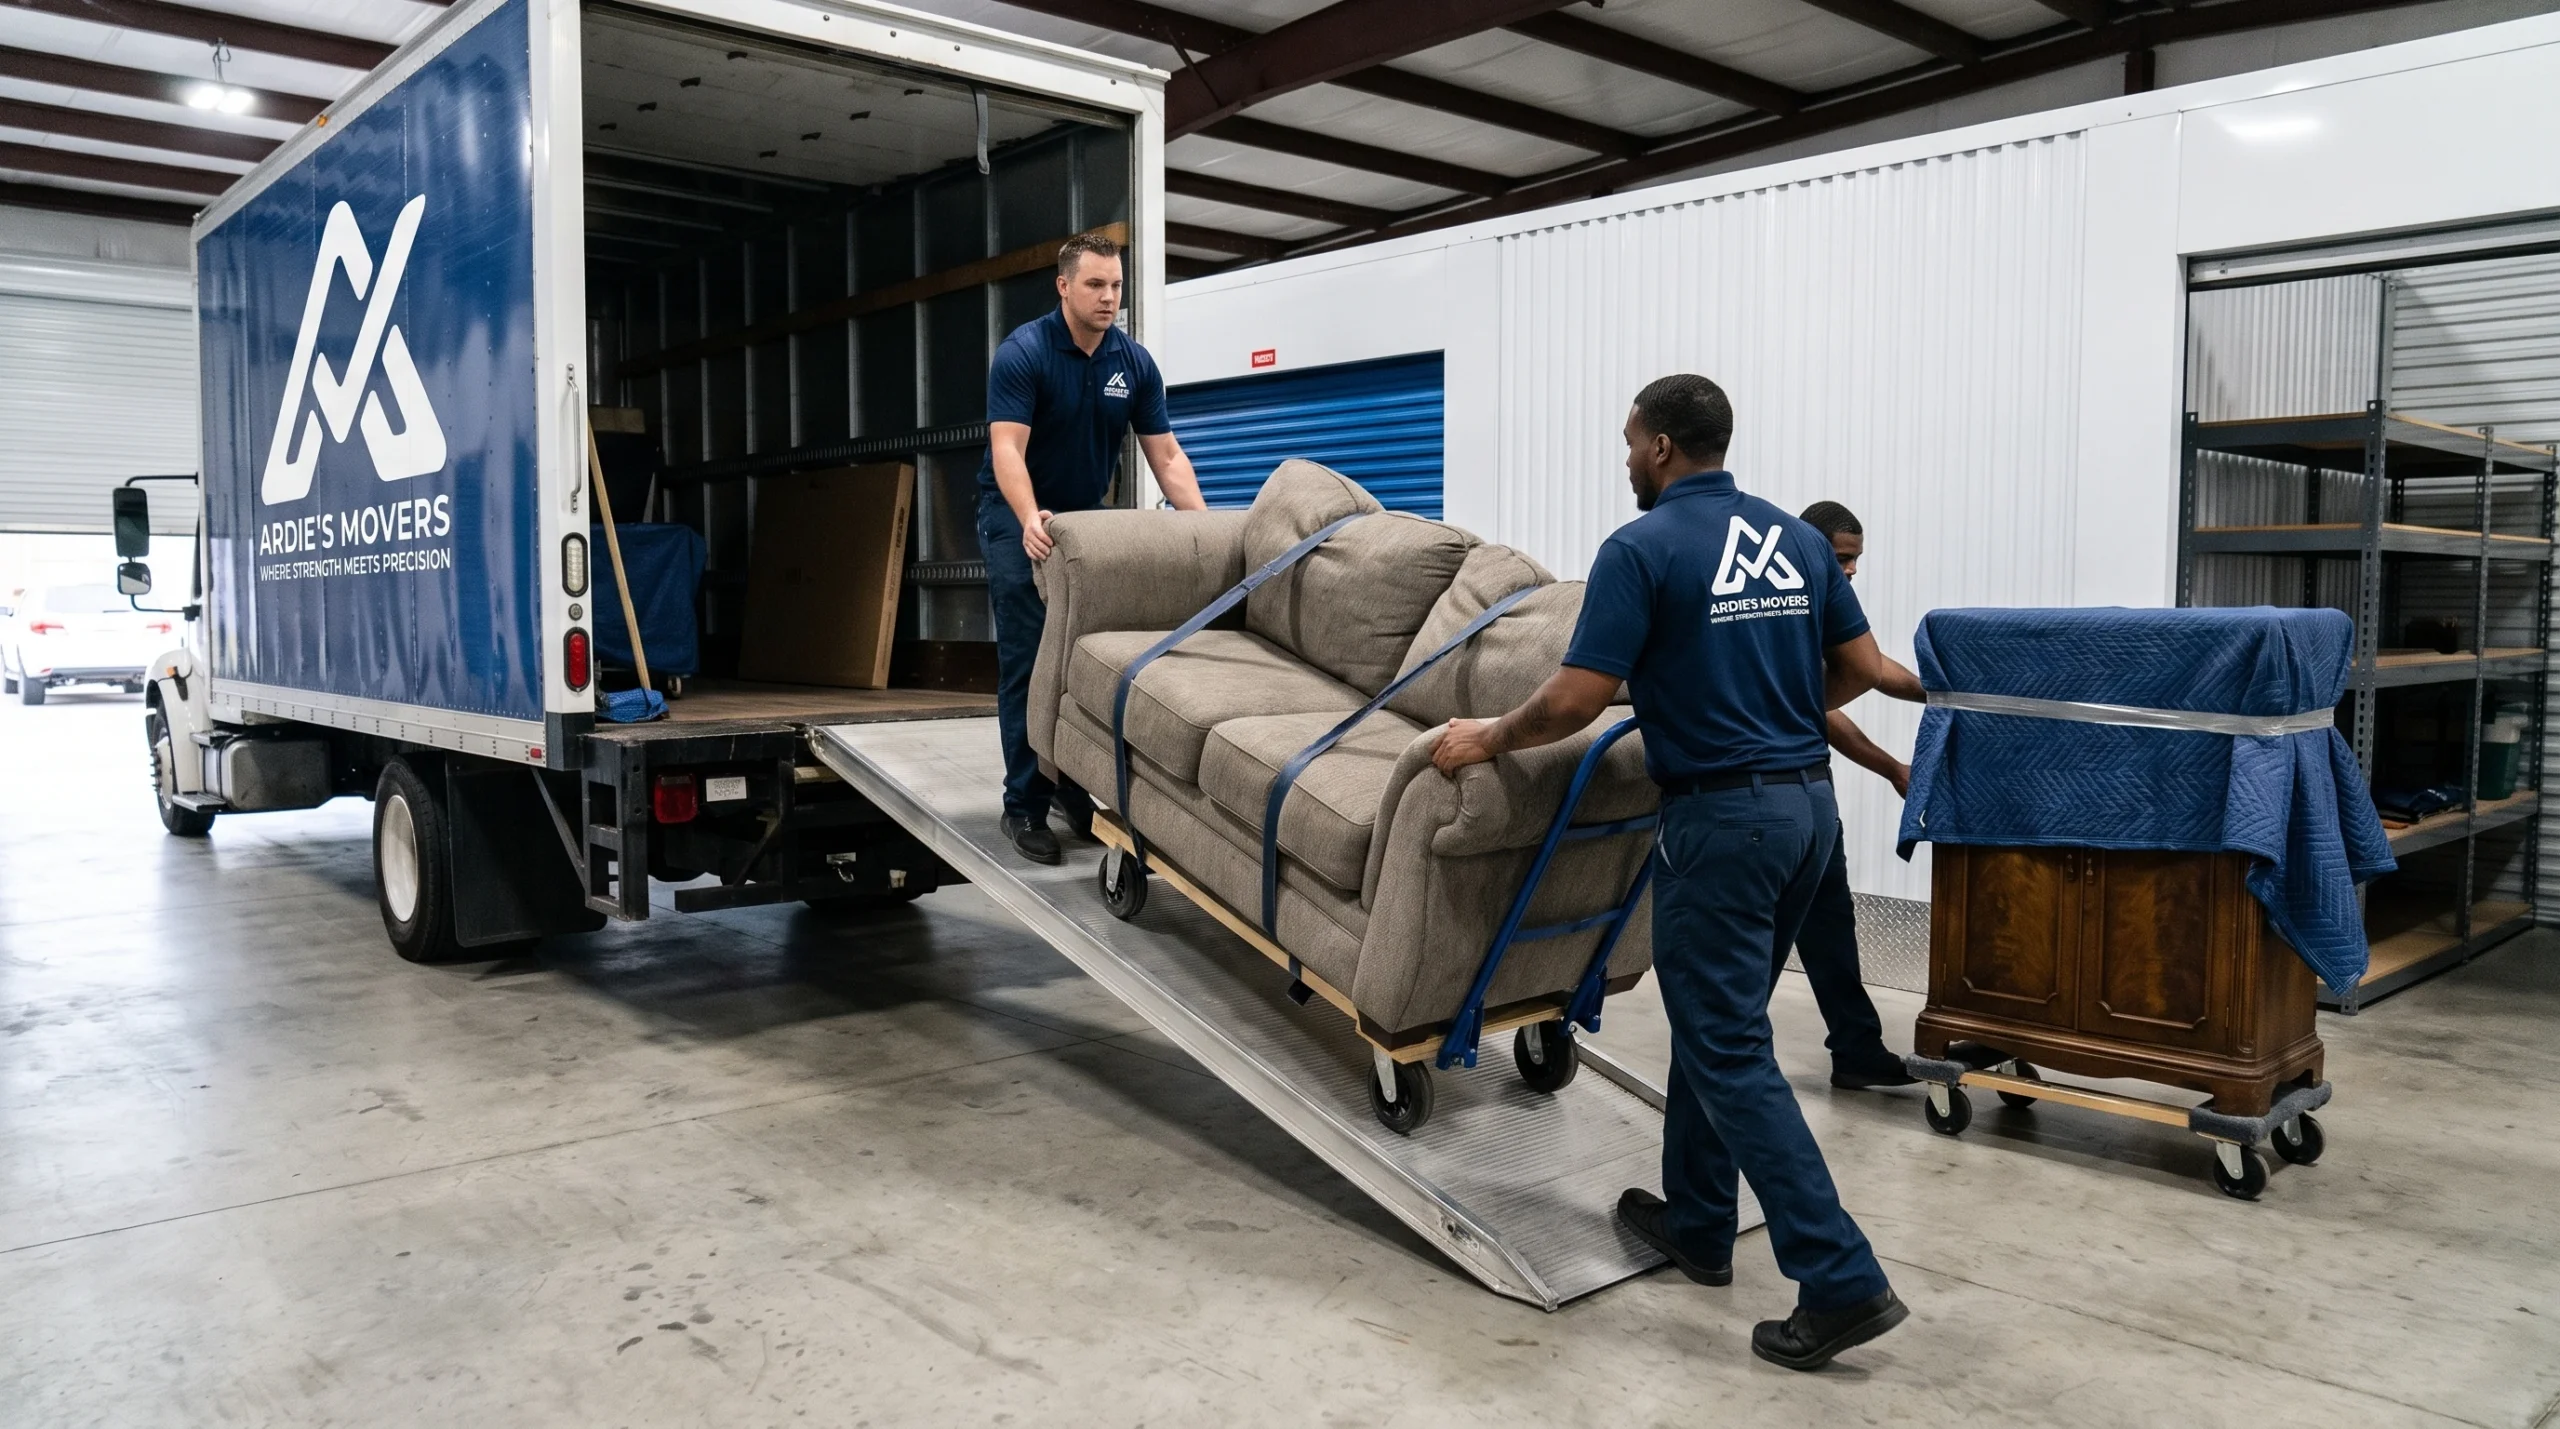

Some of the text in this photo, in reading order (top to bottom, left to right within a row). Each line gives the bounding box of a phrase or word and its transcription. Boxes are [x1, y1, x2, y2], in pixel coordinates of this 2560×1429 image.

[259, 494, 451, 556] ARDIE'S MOVERS
[259, 548, 451, 582] WHERE STRENGTH MEETS PRECISION
[1710, 595, 1809, 615] ARDIES MOVERS
